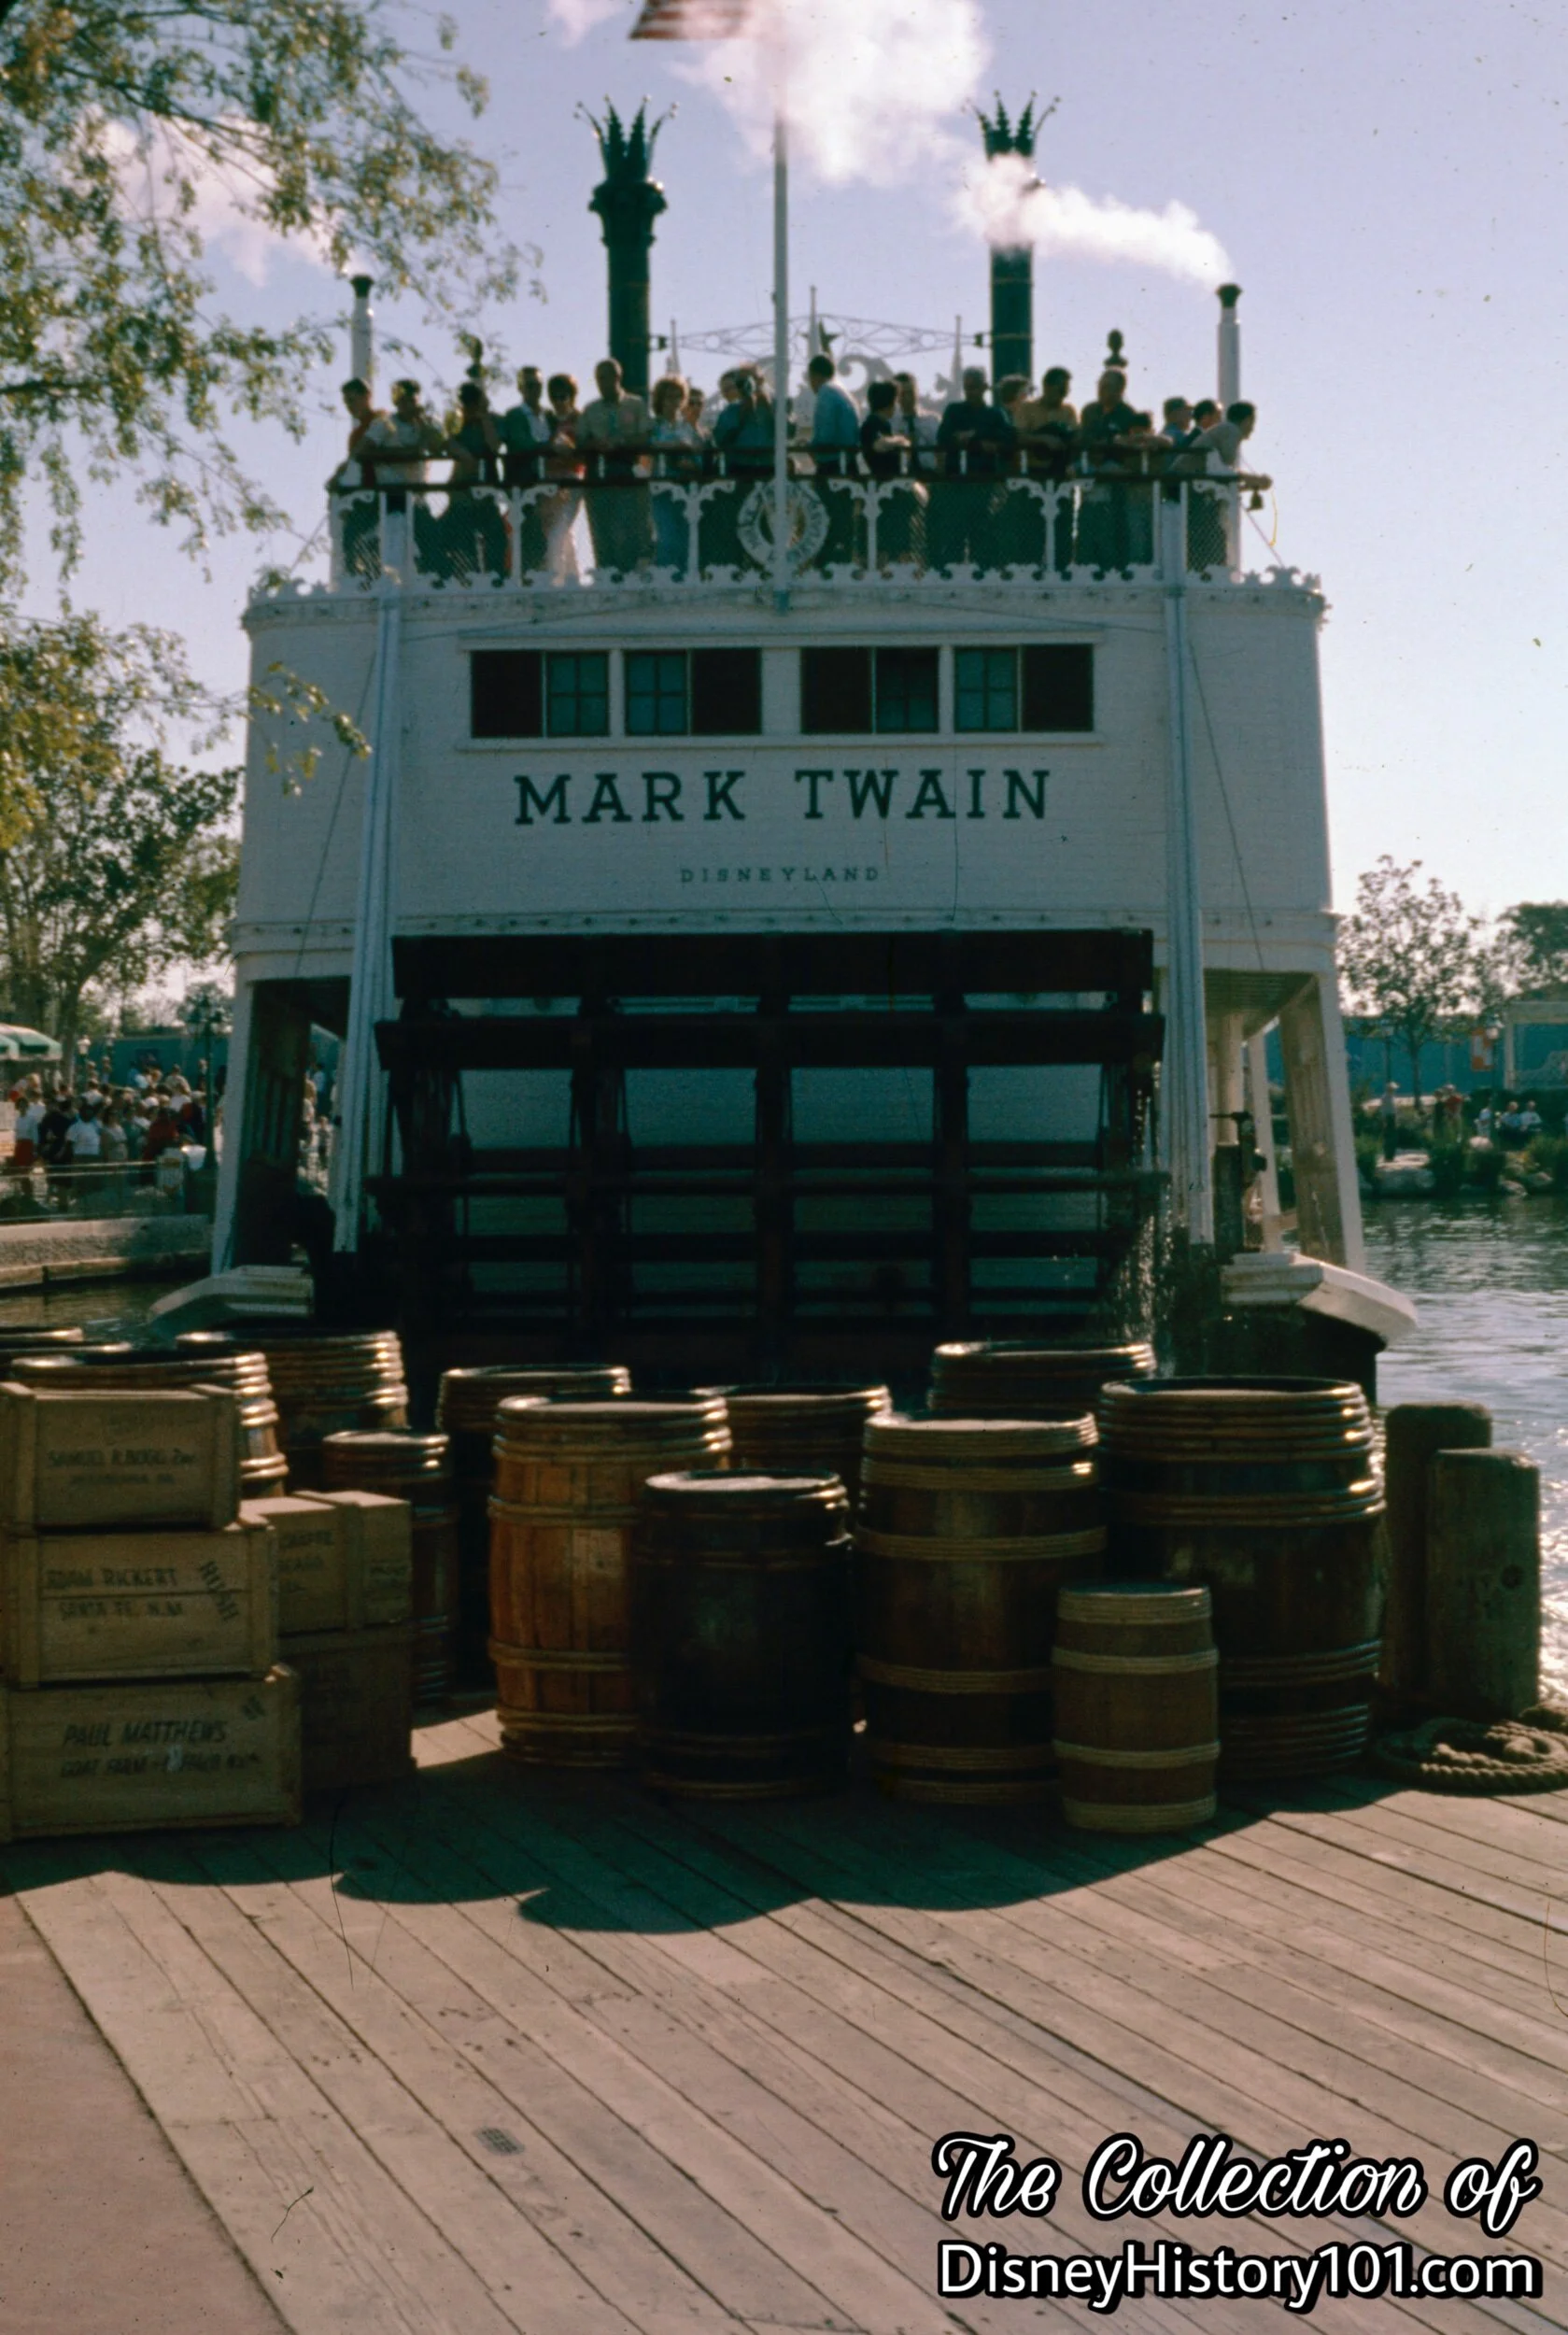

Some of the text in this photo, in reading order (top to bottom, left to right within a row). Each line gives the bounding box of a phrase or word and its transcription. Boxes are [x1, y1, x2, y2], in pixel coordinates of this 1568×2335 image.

[514, 769, 1051, 826] MARK TWAIN
[681, 868, 880, 884] DISNEYLAND
[62, 1719, 228, 1748] PAUL MATTHEWS
